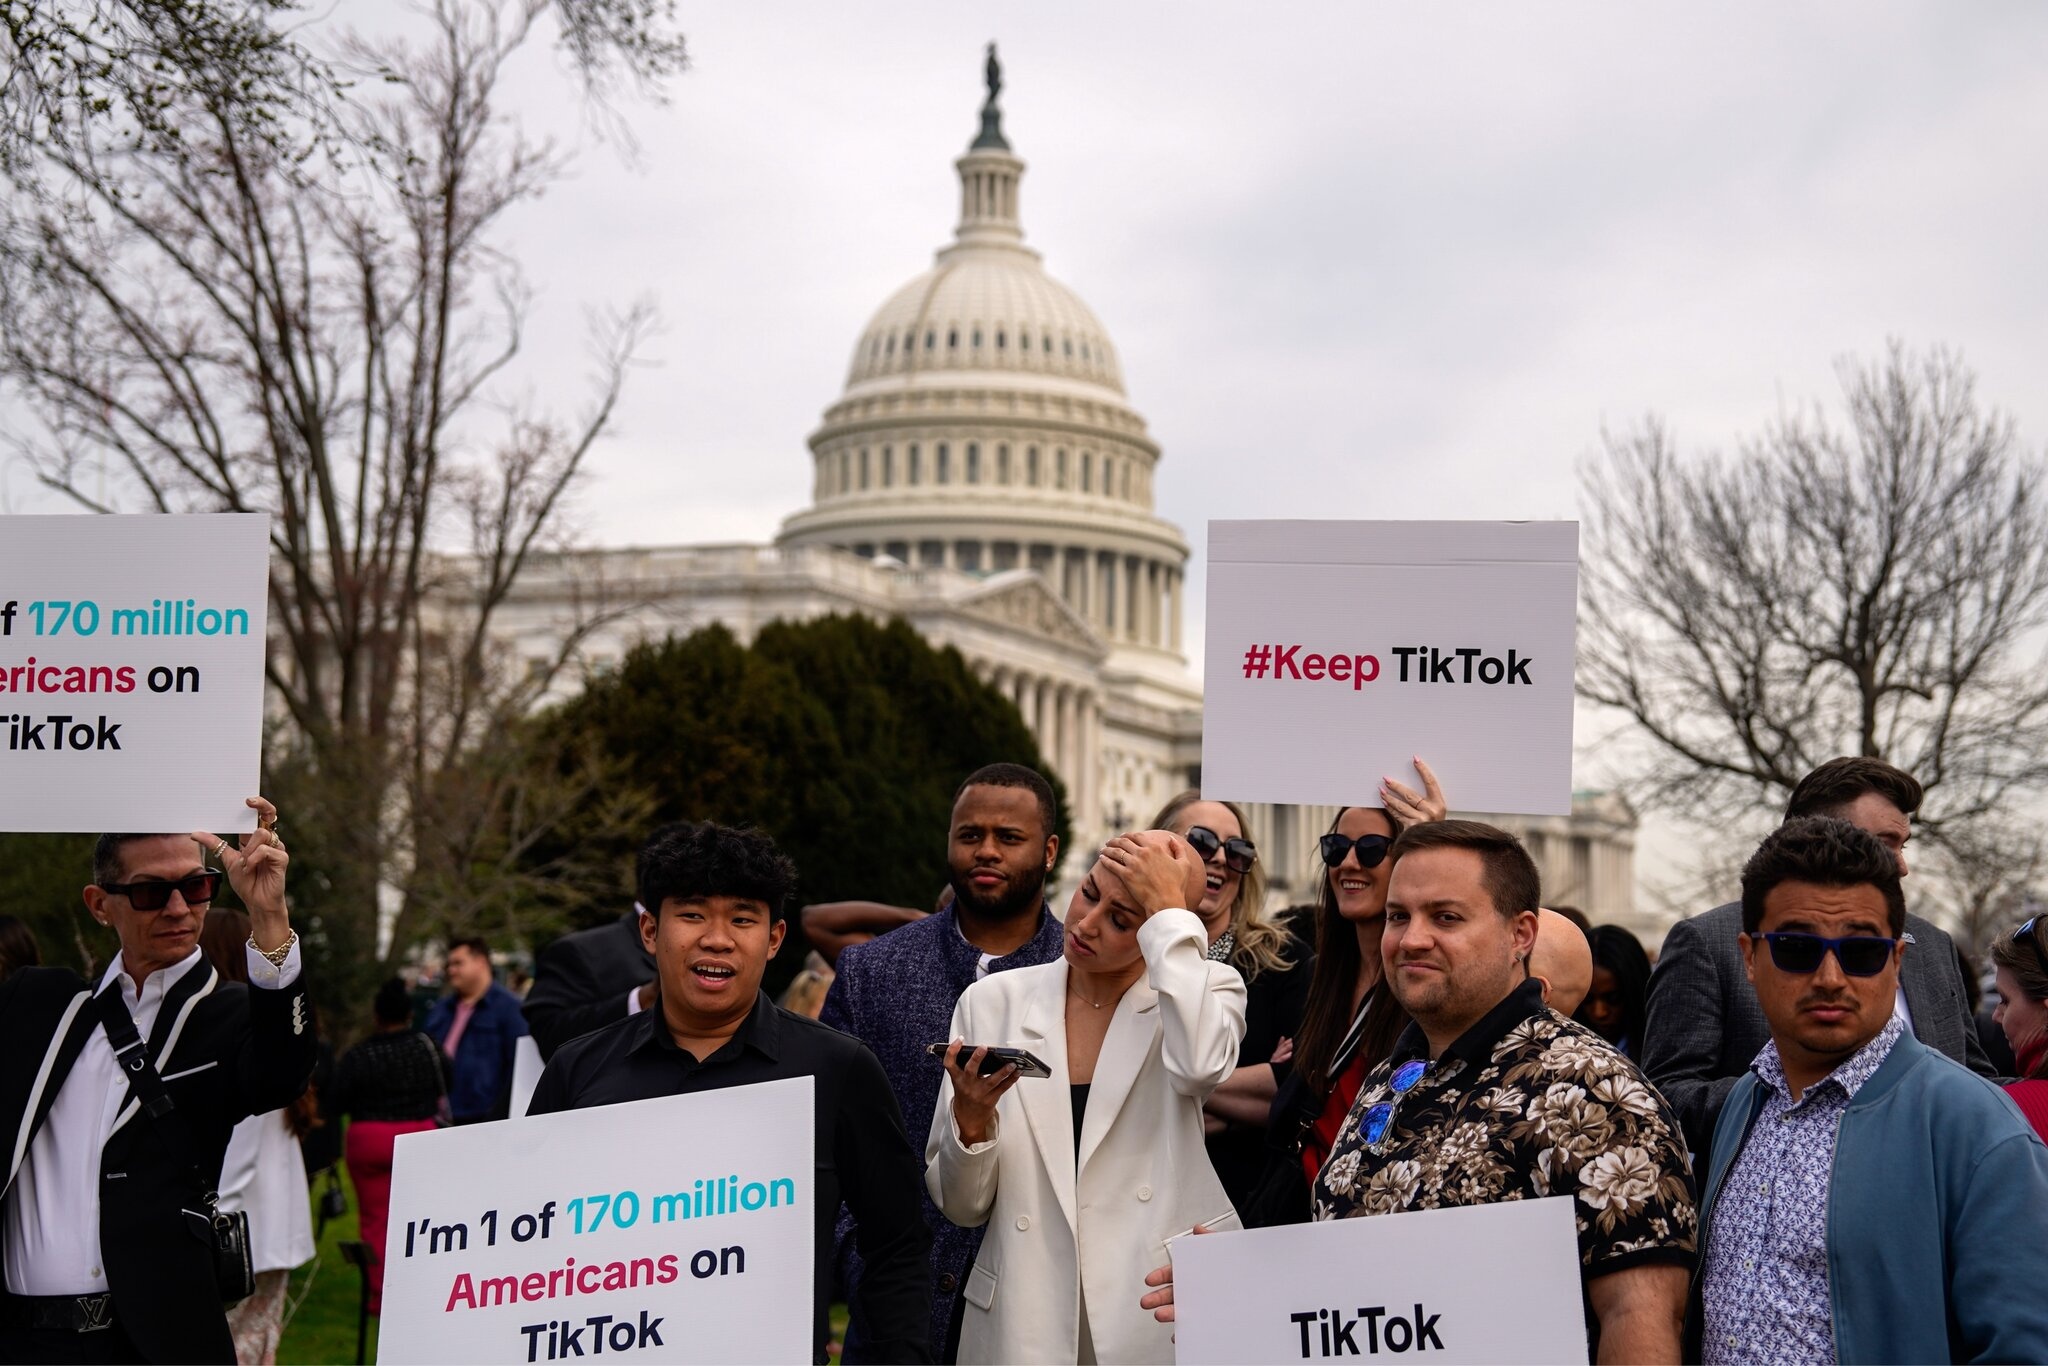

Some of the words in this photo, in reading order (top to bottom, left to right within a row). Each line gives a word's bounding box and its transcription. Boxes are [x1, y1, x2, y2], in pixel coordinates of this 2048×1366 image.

[0, 600, 18, 636] f
[28, 600, 100, 637] 170
[111, 598, 249, 636] million
[0, 656, 136, 694] ricans
[147, 665, 200, 694] on
[1242, 644, 1381, 691] #Keep
[1391, 645, 1533, 685] TikTok
[480, 1209, 498, 1247] 1
[510, 1200, 557, 1243] of
[566, 1190, 641, 1235] 170
[652, 1174, 795, 1224] million
[445, 1254, 679, 1313] Americans
[690, 1245, 745, 1279] on
[520, 1310, 665, 1363] TikTok
[1290, 1303, 1445, 1359] TikTok
